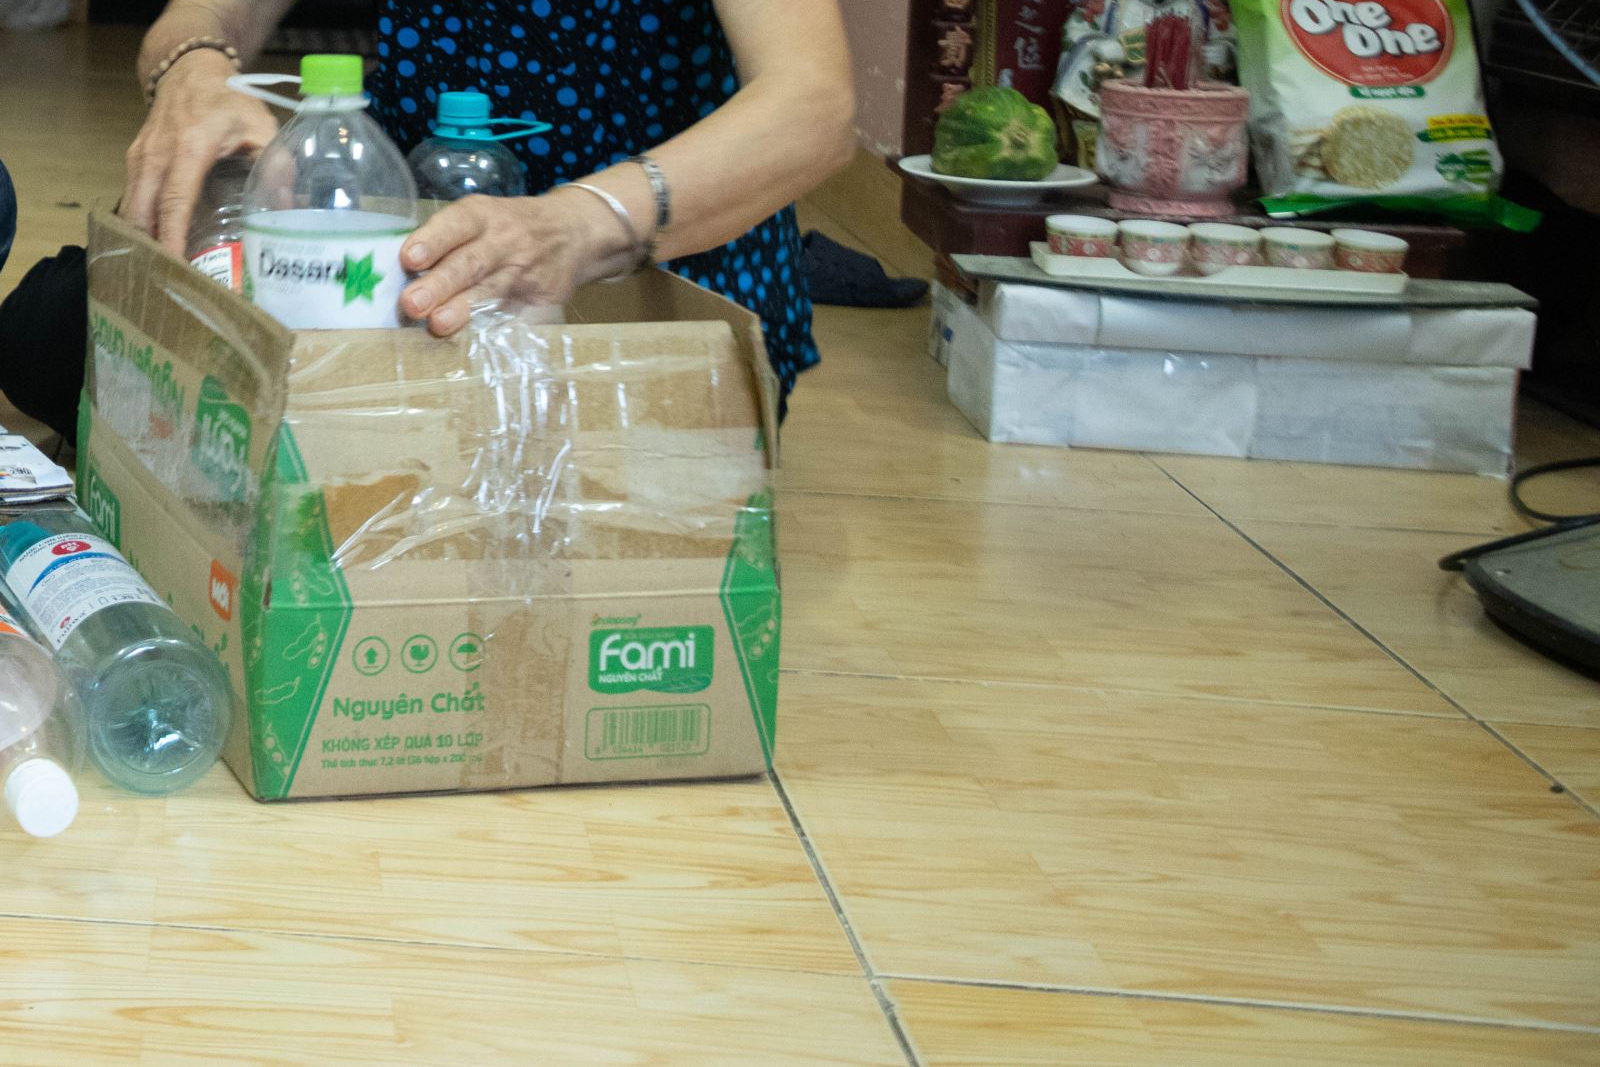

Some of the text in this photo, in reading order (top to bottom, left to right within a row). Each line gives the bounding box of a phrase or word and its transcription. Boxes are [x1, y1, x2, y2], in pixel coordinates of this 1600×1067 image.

[1342, 22, 1442, 58] One
[333, 681, 486, 721] Nguyên Chất
[321, 736, 370, 753] KHÔNG
[435, 734, 453, 748] 10
